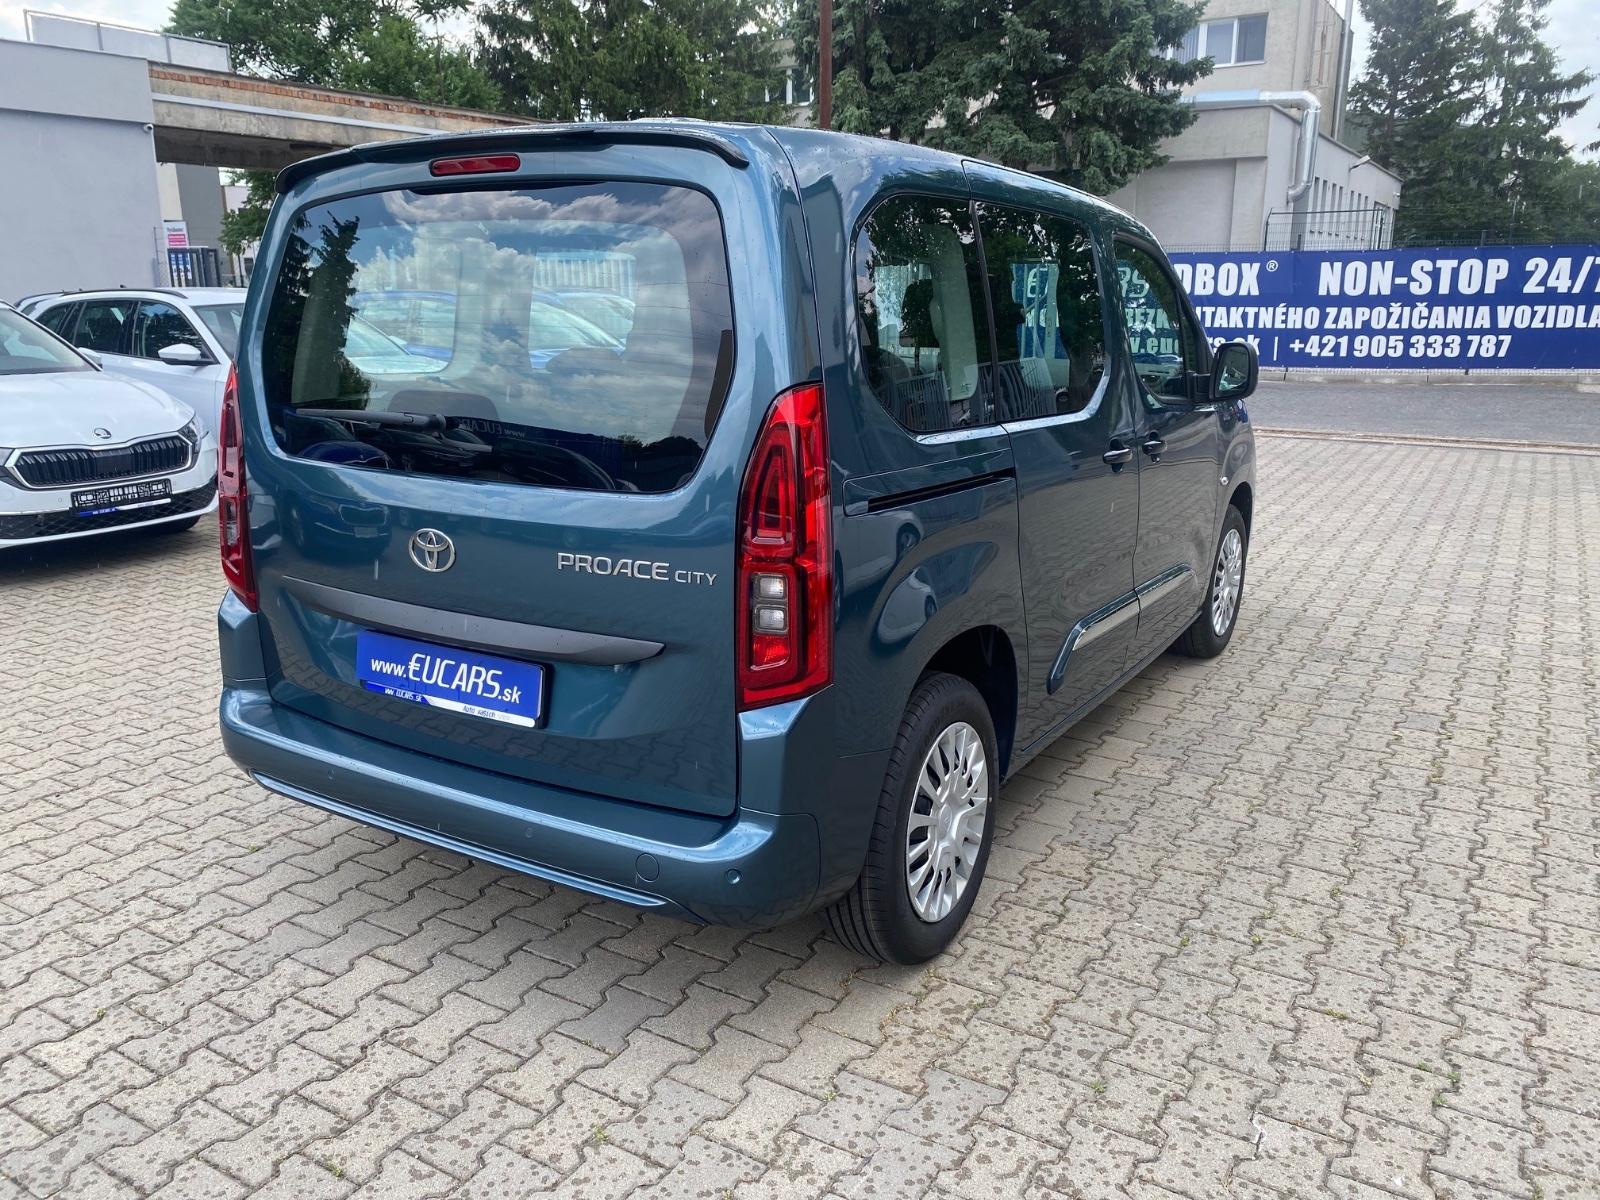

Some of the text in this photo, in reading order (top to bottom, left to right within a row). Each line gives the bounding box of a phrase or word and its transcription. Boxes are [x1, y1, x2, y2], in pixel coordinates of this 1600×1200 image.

[1318, 259, 1509, 296] NON-STOP
[1323, 302, 1491, 330] ZAPOŽIČANIA
[1289, 335, 1349, 357] +421
[1353, 335, 1404, 358] 905
[1408, 335, 1461, 358] 333
[1466, 334, 1512, 358] 787
[557, 552, 717, 586] PROACE CITY
